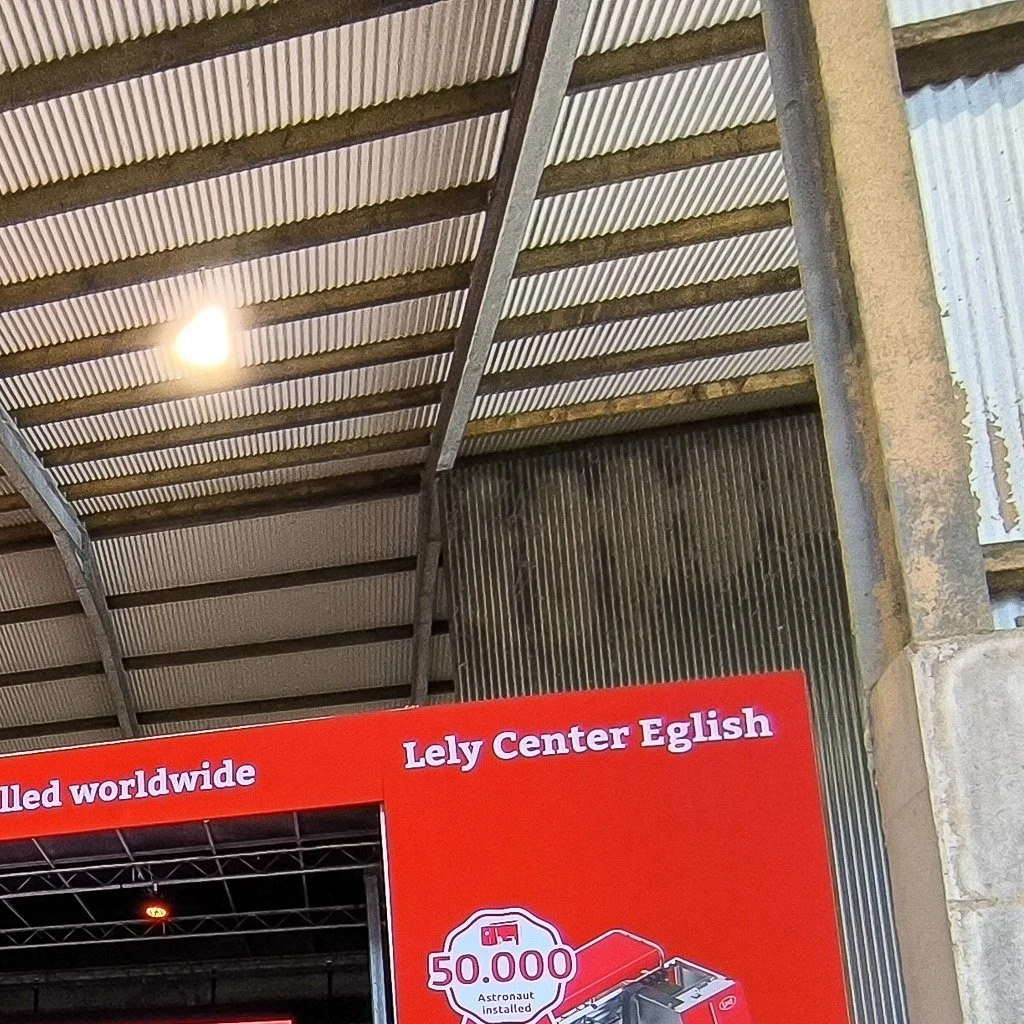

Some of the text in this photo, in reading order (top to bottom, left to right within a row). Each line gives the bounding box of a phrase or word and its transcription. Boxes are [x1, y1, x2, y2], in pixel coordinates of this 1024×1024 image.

[402, 706, 775, 772] Lely Center Eglish
[69, 758, 257, 804] worldwide
[432, 947, 573, 986] 50.000
[478, 991, 535, 1002] Astronaut
[482, 1003, 532, 1014] installed
